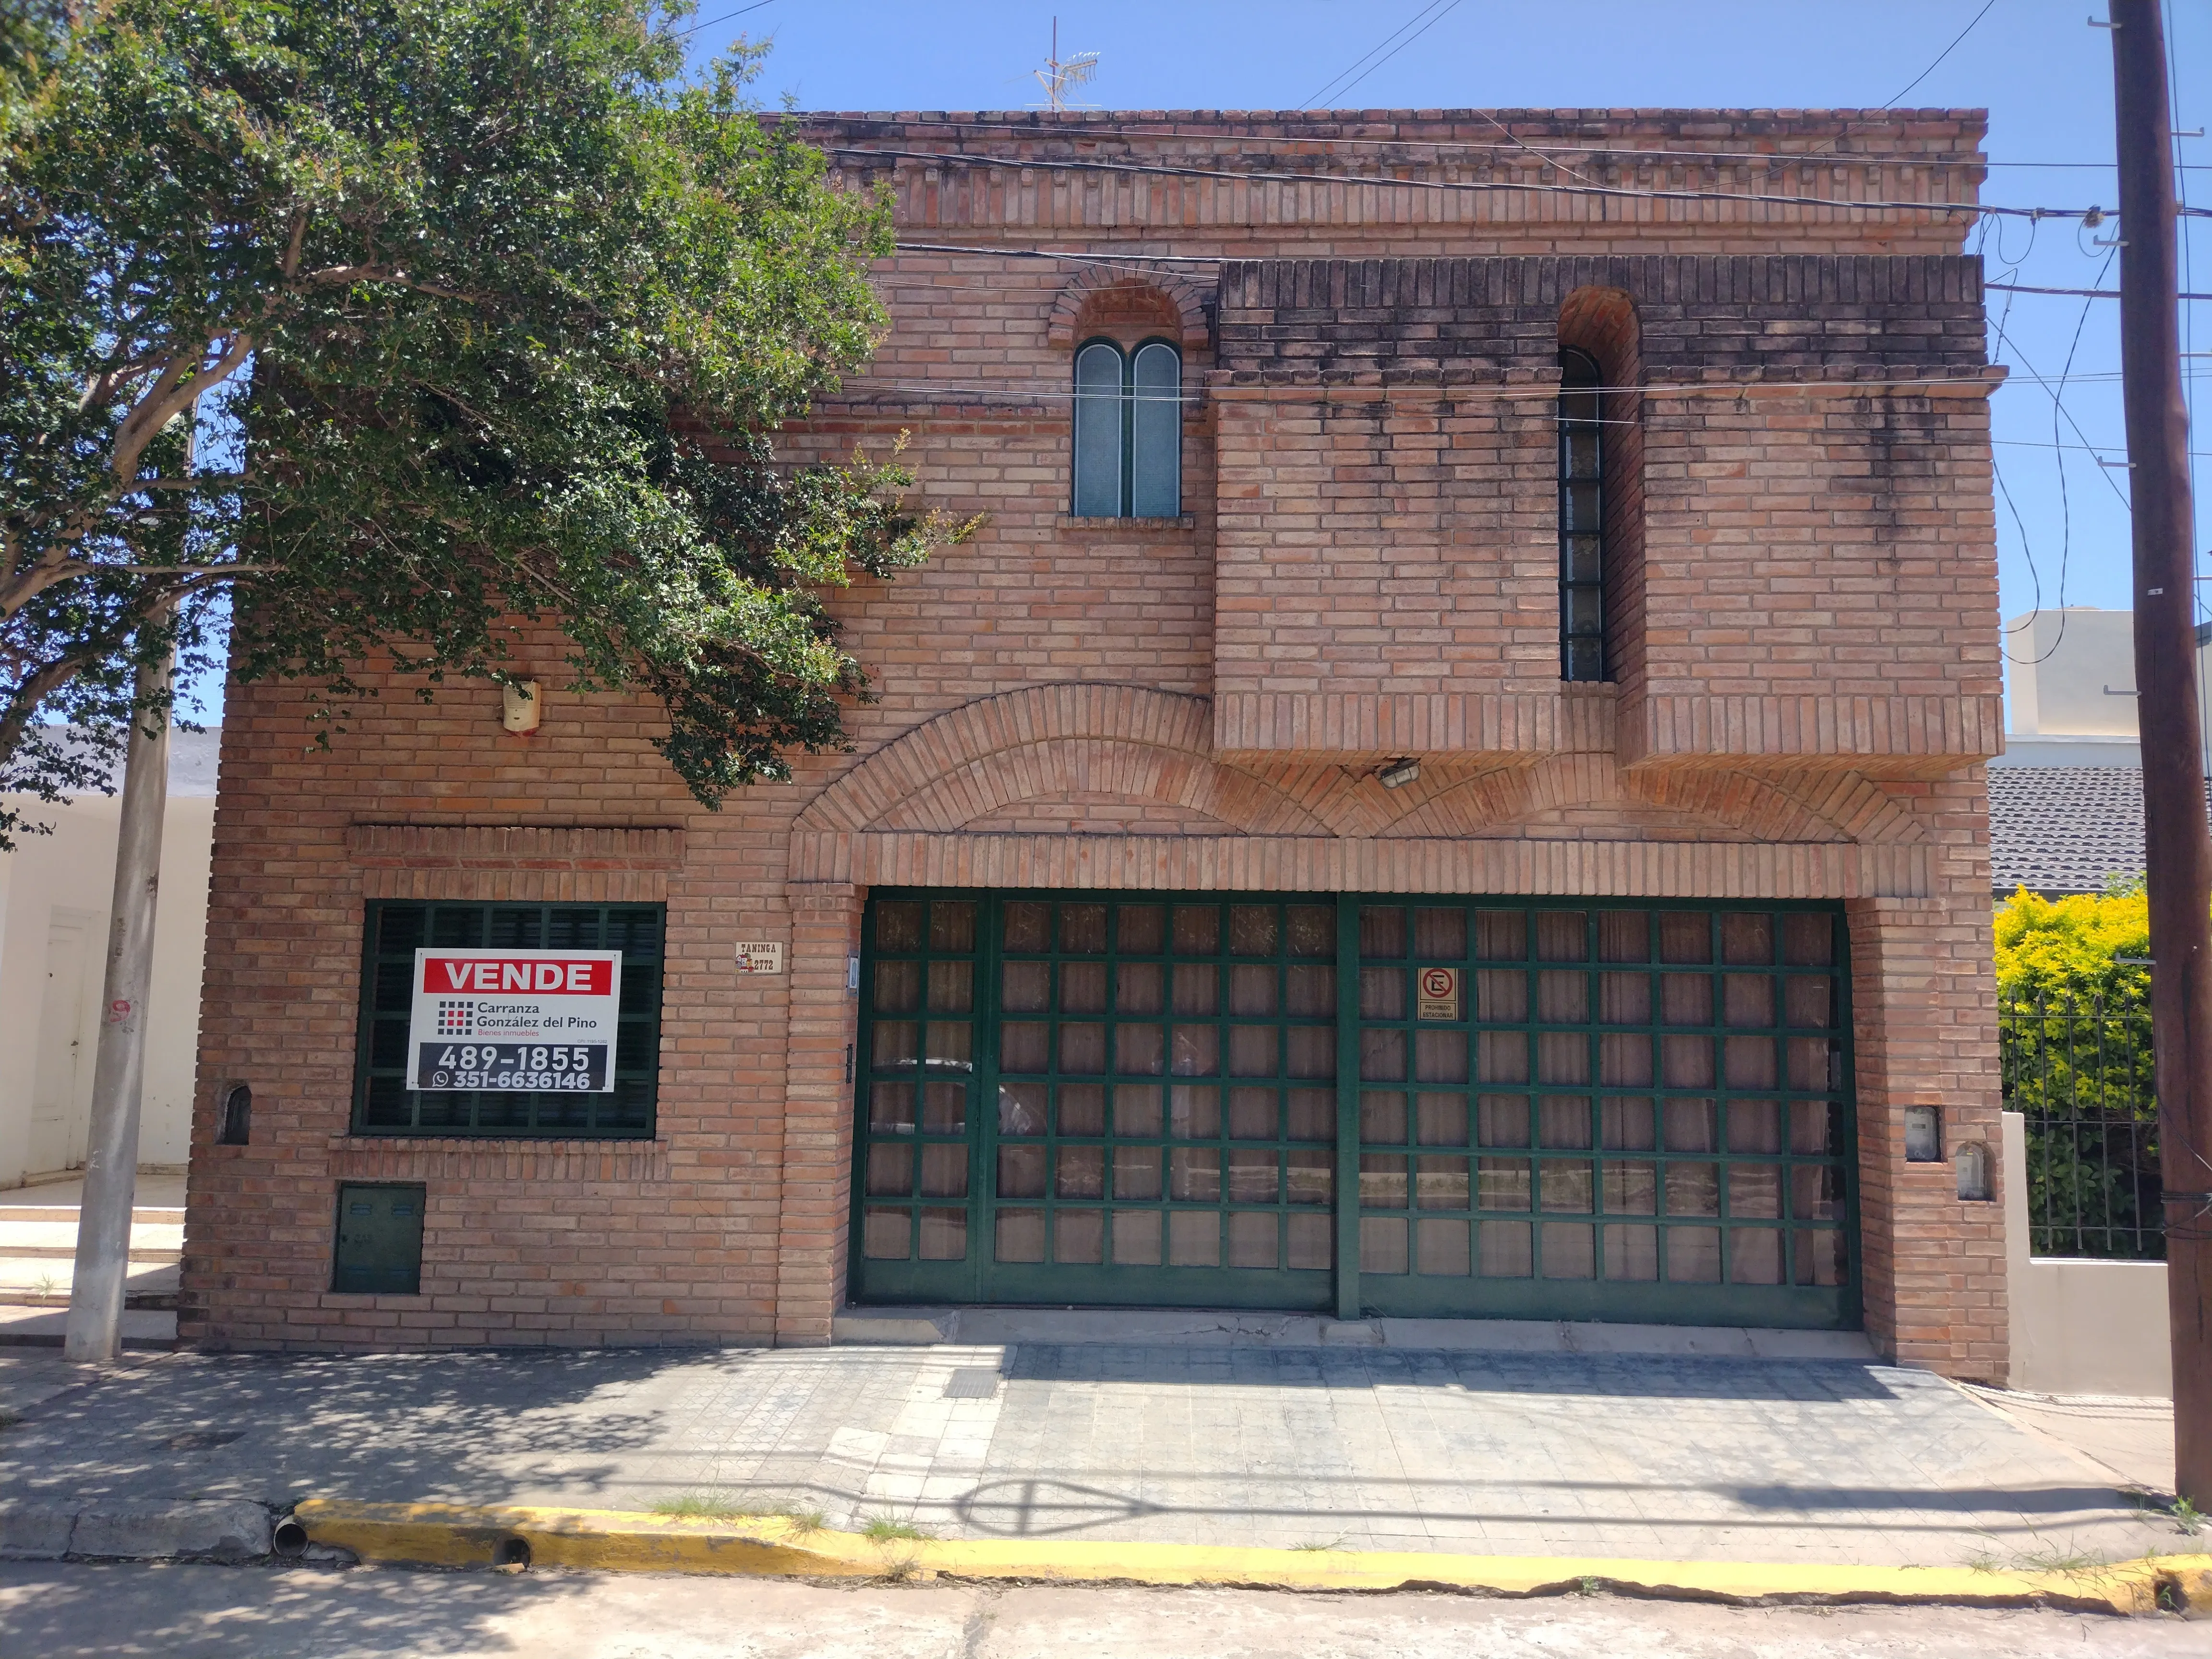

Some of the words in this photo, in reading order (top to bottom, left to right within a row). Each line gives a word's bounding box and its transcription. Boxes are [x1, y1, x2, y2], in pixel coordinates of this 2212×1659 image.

[741, 944, 776, 953] TANINGA
[754, 959, 773, 970] 2772
[445, 962, 593, 991] VENDE
[477, 1002, 540, 1013] Carranza
[477, 1016, 539, 1027] González
[543, 1017, 563, 1028] del
[567, 1017, 597, 1028] Pino
[438, 1046, 589, 1071] 489-1855
[453, 1071, 590, 1090] 351-6636146
